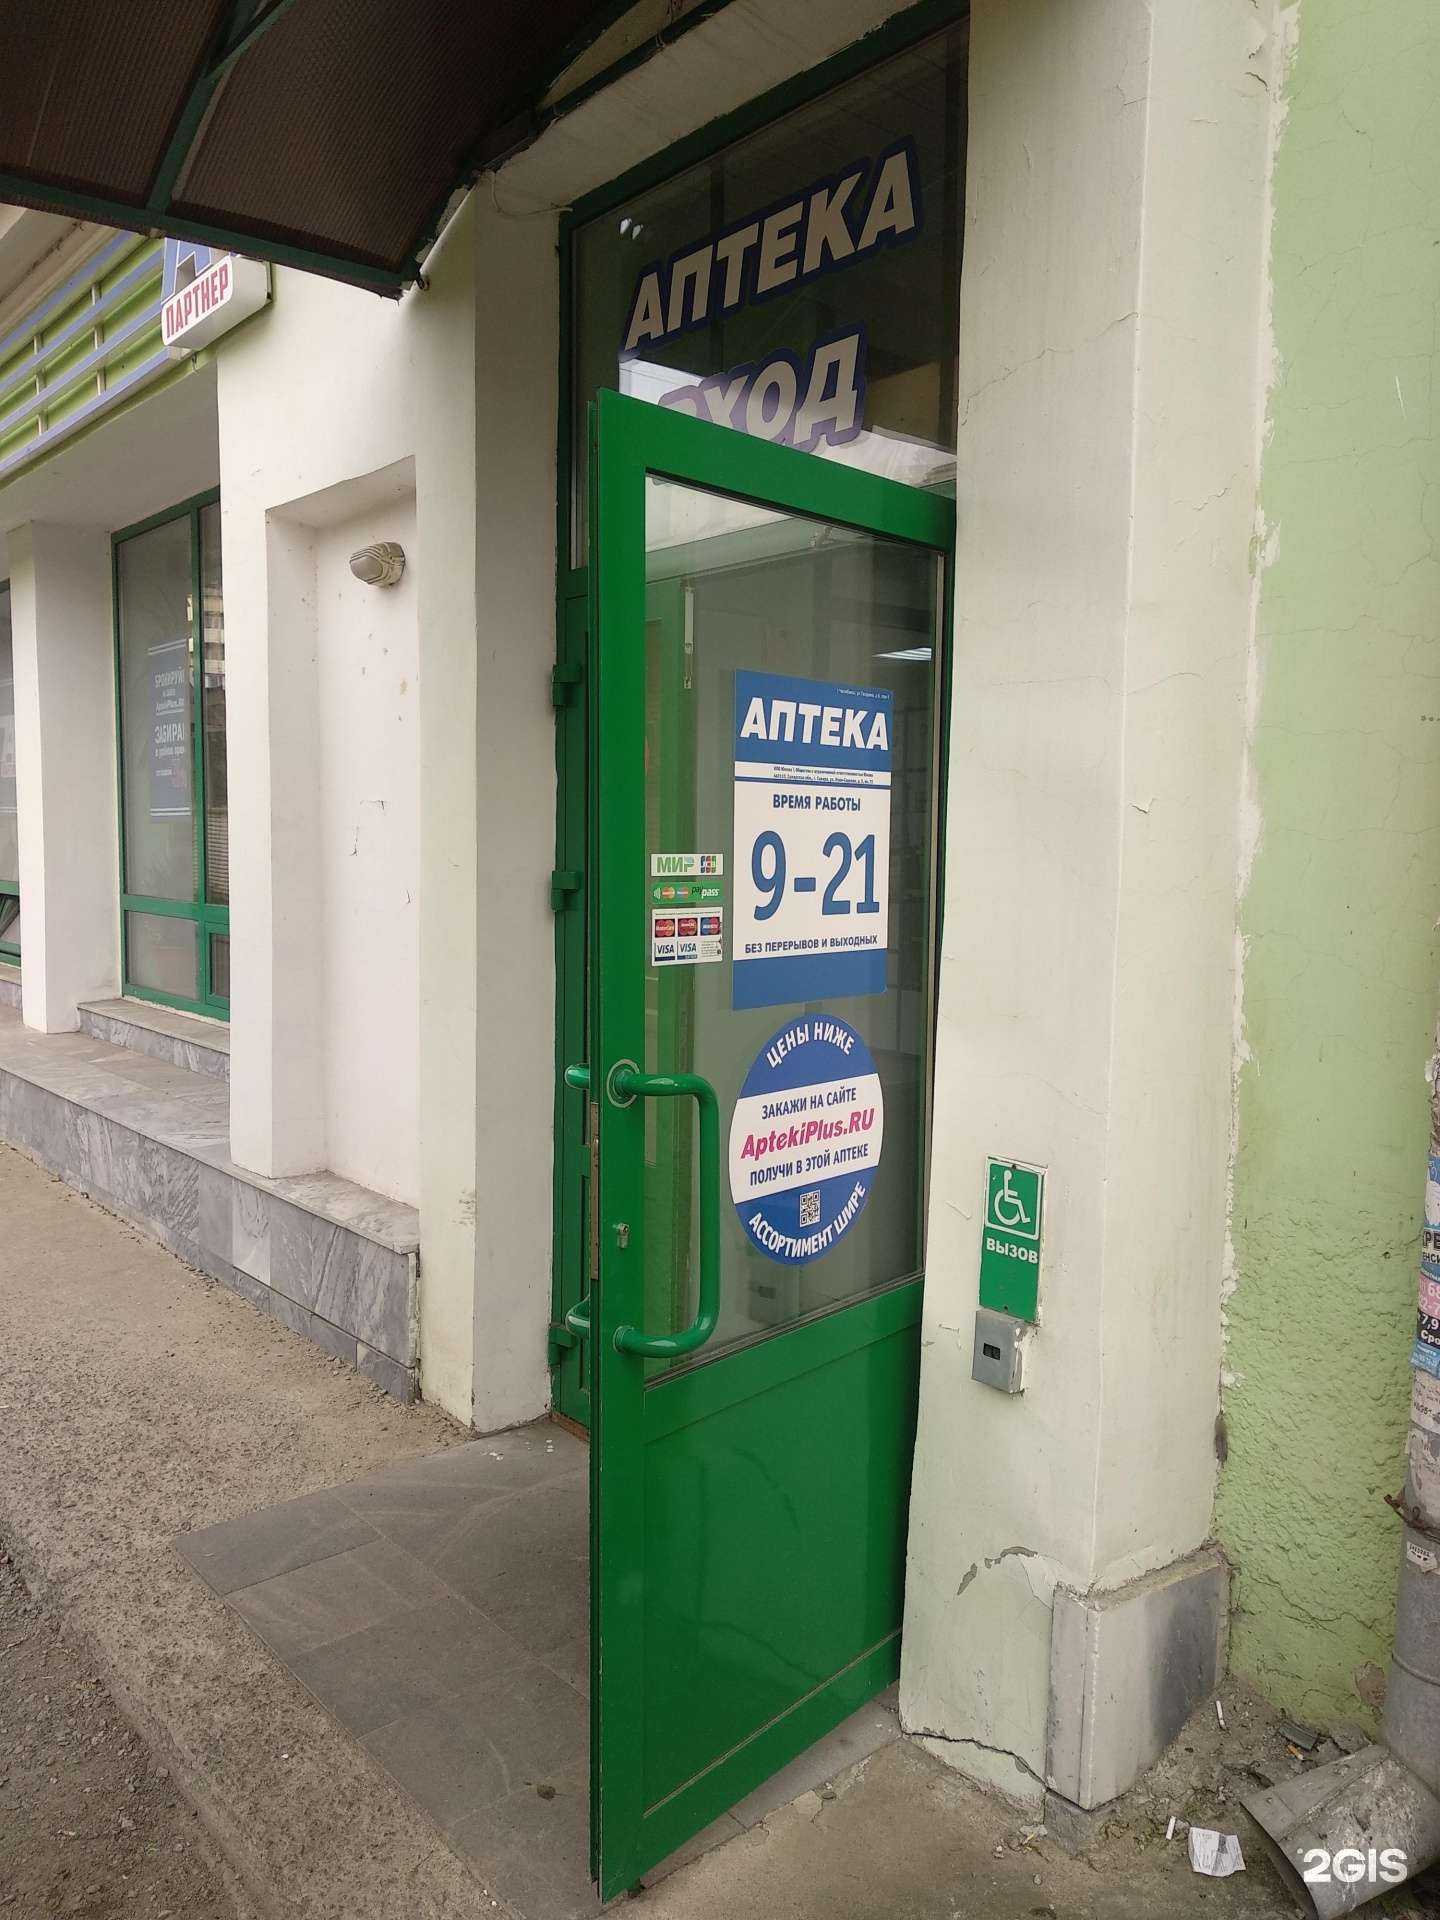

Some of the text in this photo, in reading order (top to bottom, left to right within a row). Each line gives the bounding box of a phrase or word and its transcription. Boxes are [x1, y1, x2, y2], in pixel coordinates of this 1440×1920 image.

[622, 149, 916, 354] АПТЕКА
[165, 262, 230, 339] ПАРТНЕР
[660, 333, 861, 444] ХОД
[740, 696, 889, 751] АПТЕКА
[773, 794, 861, 812] ВРЕМЯ РАБОТЫ
[657, 944, 675, 954] VISA
[680, 943, 697, 953] VISA
[745, 934, 878, 953] БЕЗ ПЕРЕРЫВОВ И ВЫХОДНЫХ
[766, 1021, 855, 1068] ЦЕНЫ НИЖЕ
[762, 1087, 857, 1120] ЗАКАЖИ НА САЙТЕ
[740, 1107, 875, 1161] AptekiPlus.RU
[750, 1143, 869, 1186] ПОЛУЧИ В ЭТОЙ АПТЕКЕ
[748, 1181, 866, 1258] АССОРТИМЕНТ ШИРЕ
[986, 1237, 1039, 1264] ВЫЗОВ
